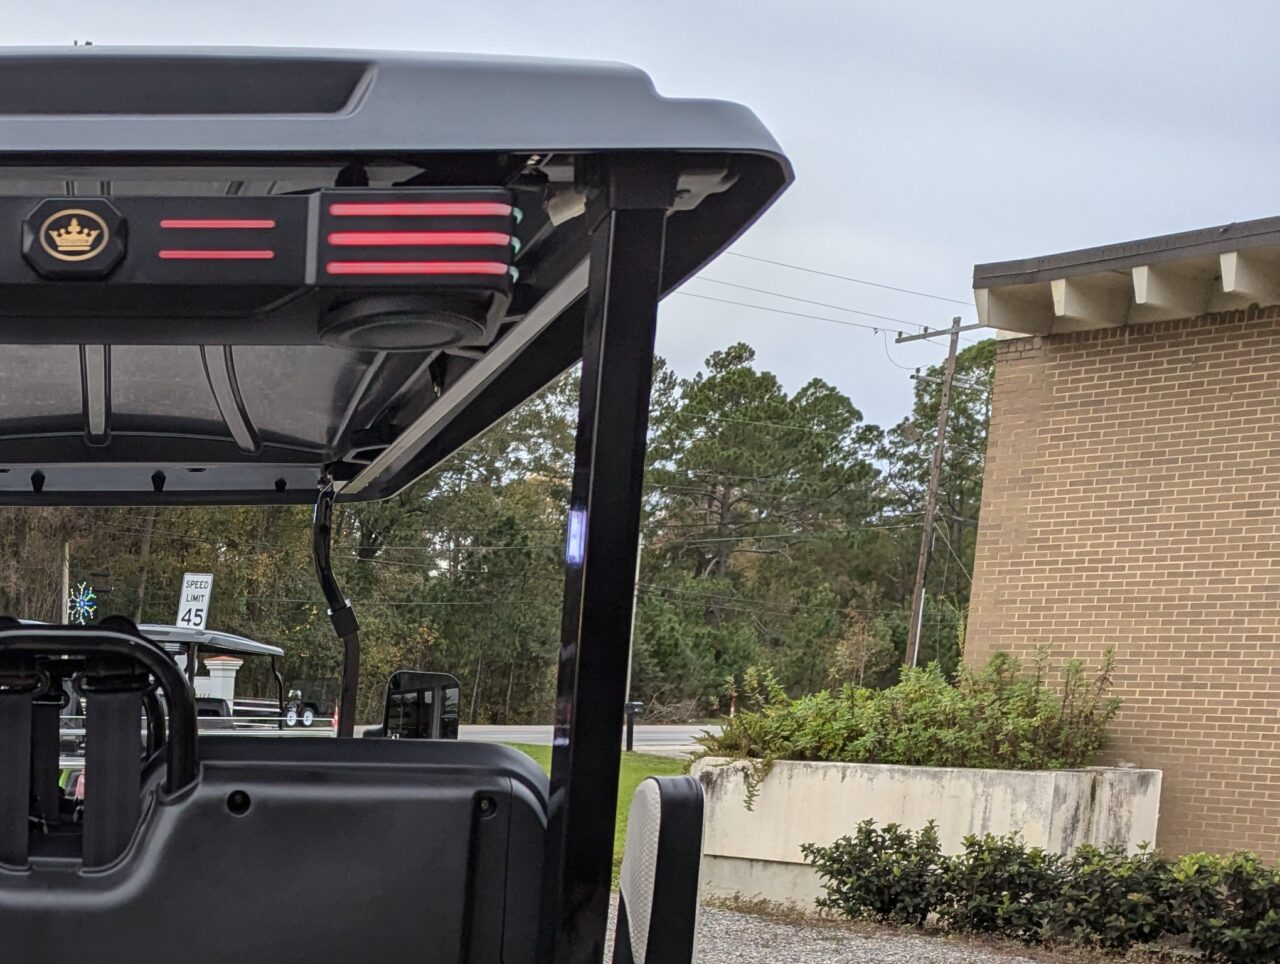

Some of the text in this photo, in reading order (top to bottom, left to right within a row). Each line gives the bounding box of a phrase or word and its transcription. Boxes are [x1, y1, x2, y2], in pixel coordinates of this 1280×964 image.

[185, 580, 209, 589] SPEED
[186, 594, 205, 603] LIMIT
[181, 608, 204, 626] 45
